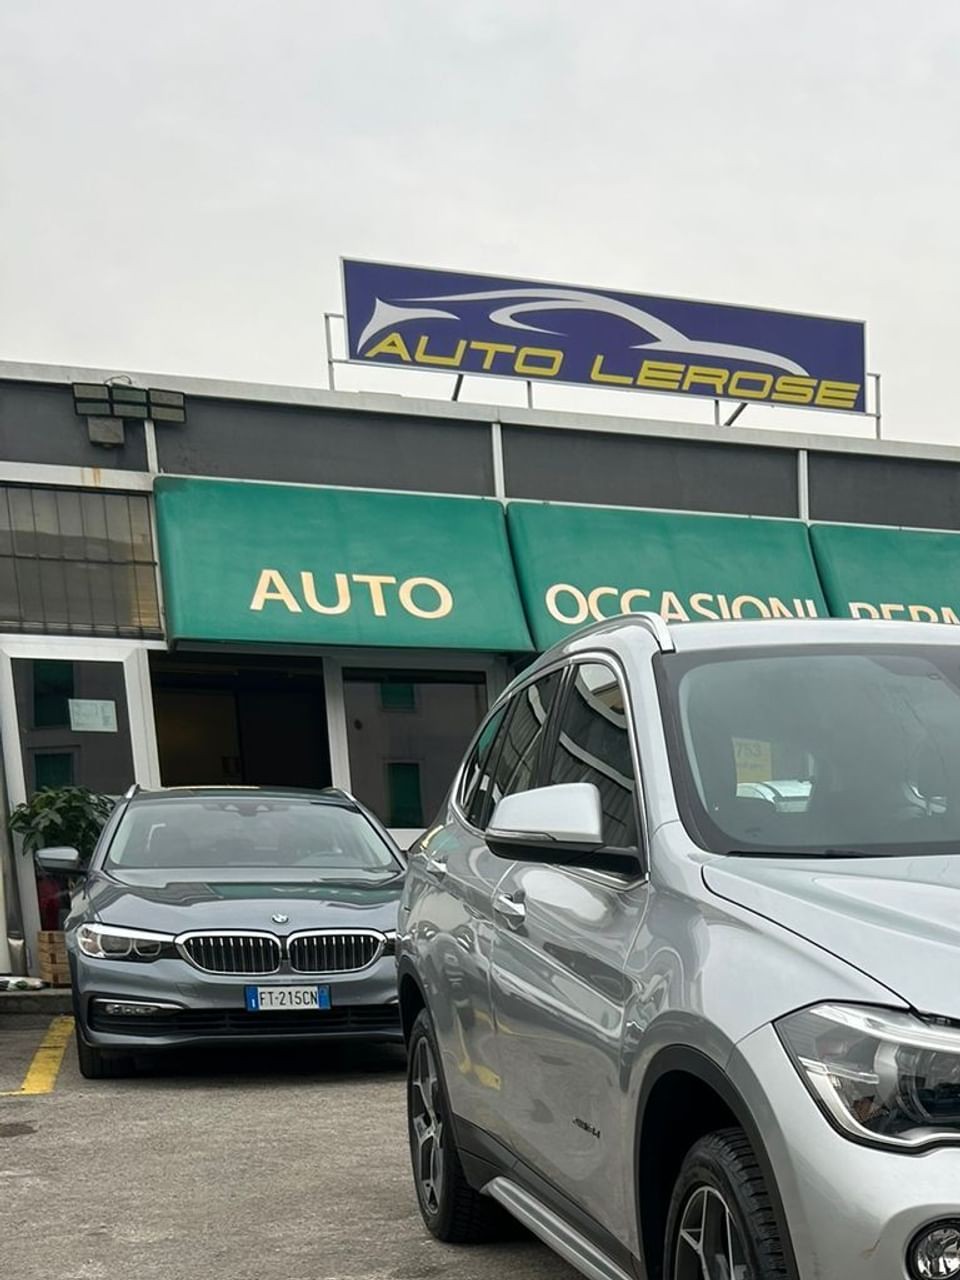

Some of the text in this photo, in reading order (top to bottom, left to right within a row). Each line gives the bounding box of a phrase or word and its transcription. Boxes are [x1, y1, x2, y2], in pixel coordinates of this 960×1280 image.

[365, 332, 862, 408] AUTO LEROSE
[250, 569, 454, 619] AUTO
